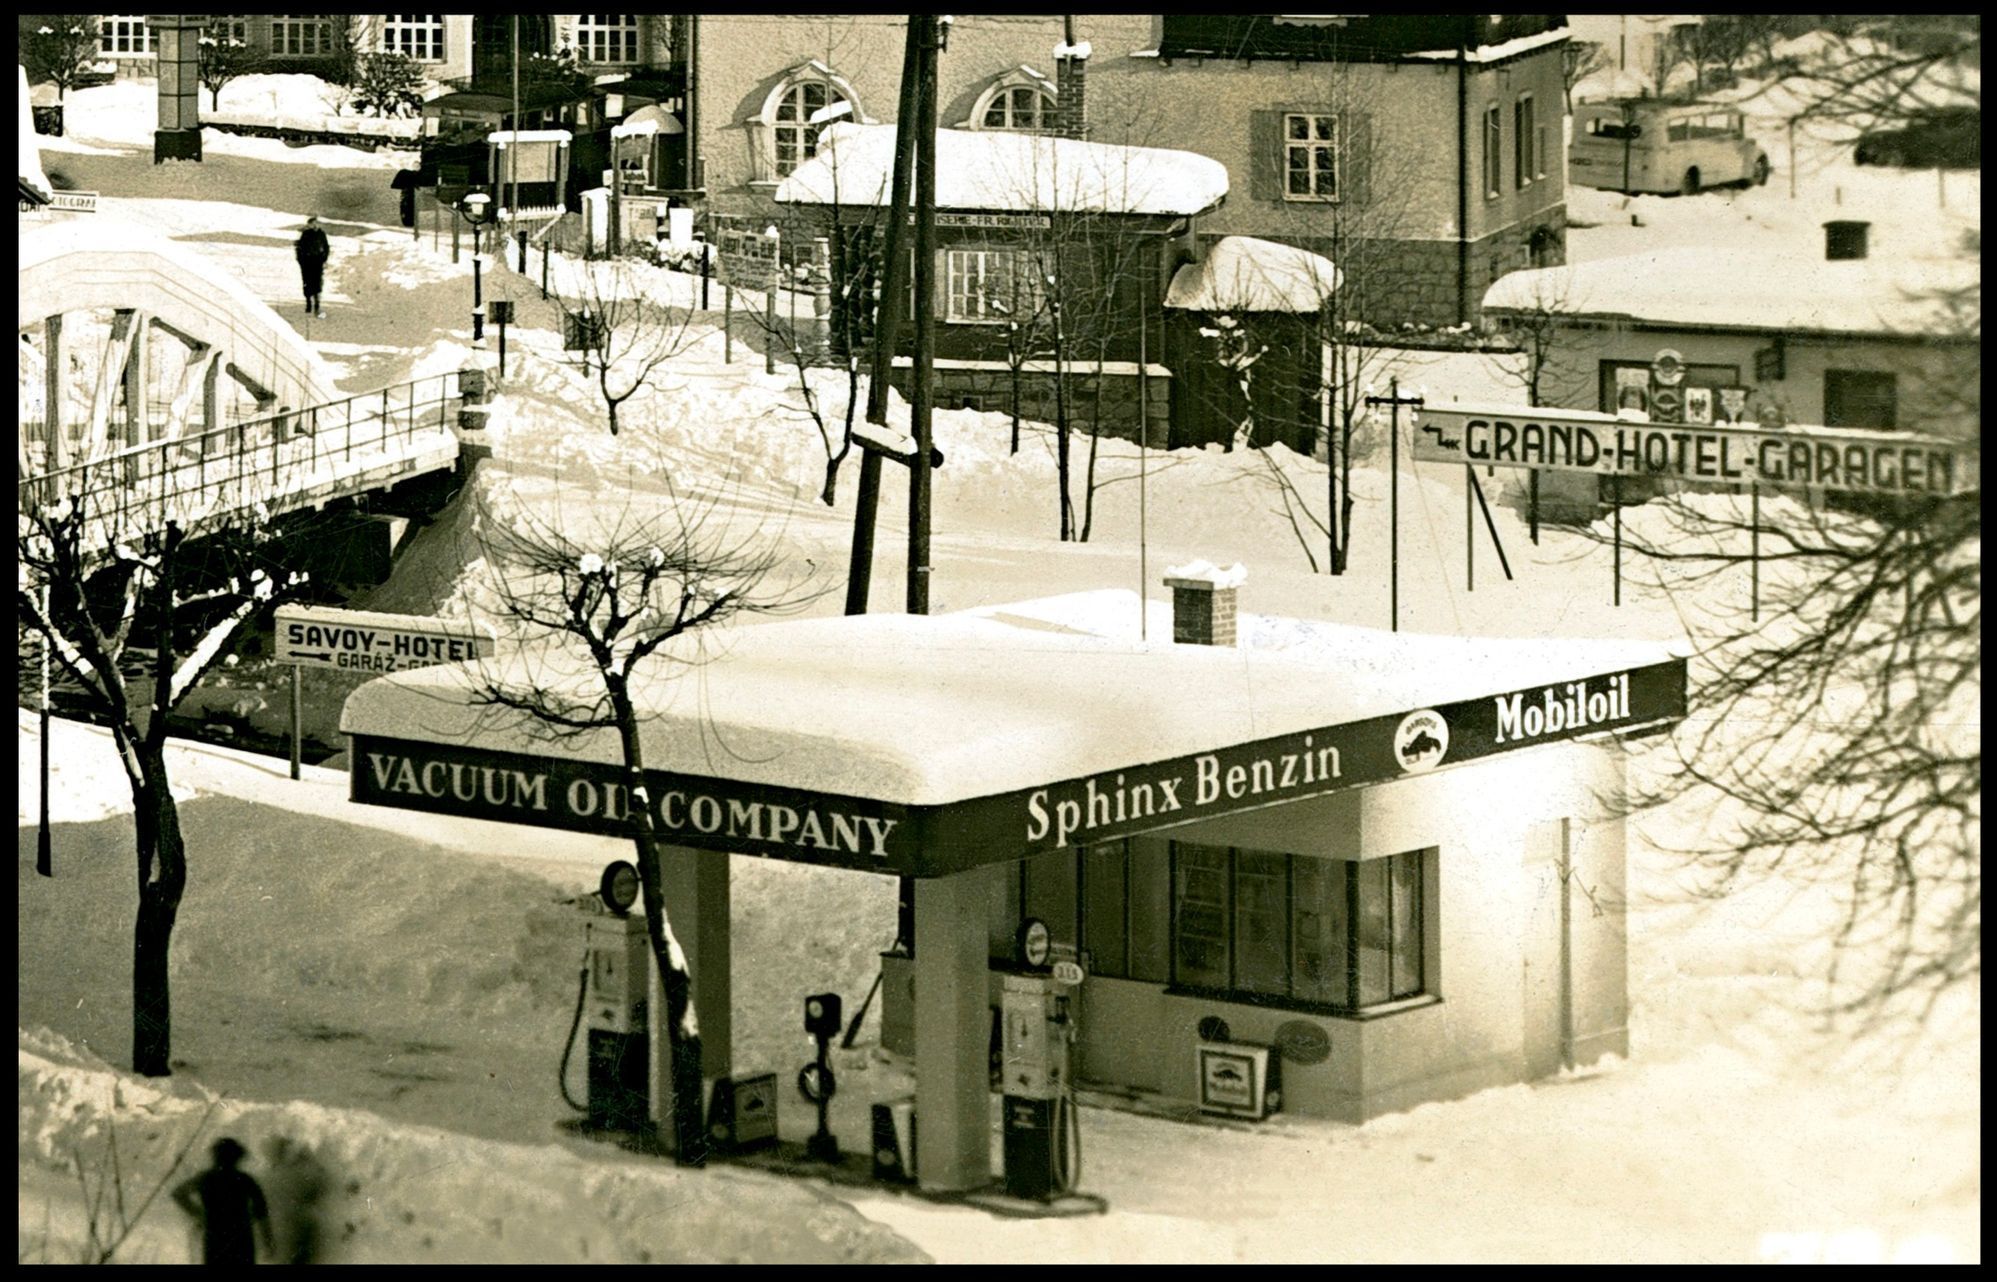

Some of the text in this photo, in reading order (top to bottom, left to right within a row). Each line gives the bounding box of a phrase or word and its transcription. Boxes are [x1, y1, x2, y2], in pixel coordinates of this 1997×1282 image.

[288, 624, 478, 662] SAVOY-HOTEL
[1495, 673, 1631, 743] Mobiloil
[367, 753, 548, 811] VACUUM
[660, 790, 898, 857] COMPANY
[1027, 735, 1342, 848] Sphinx Benzin
